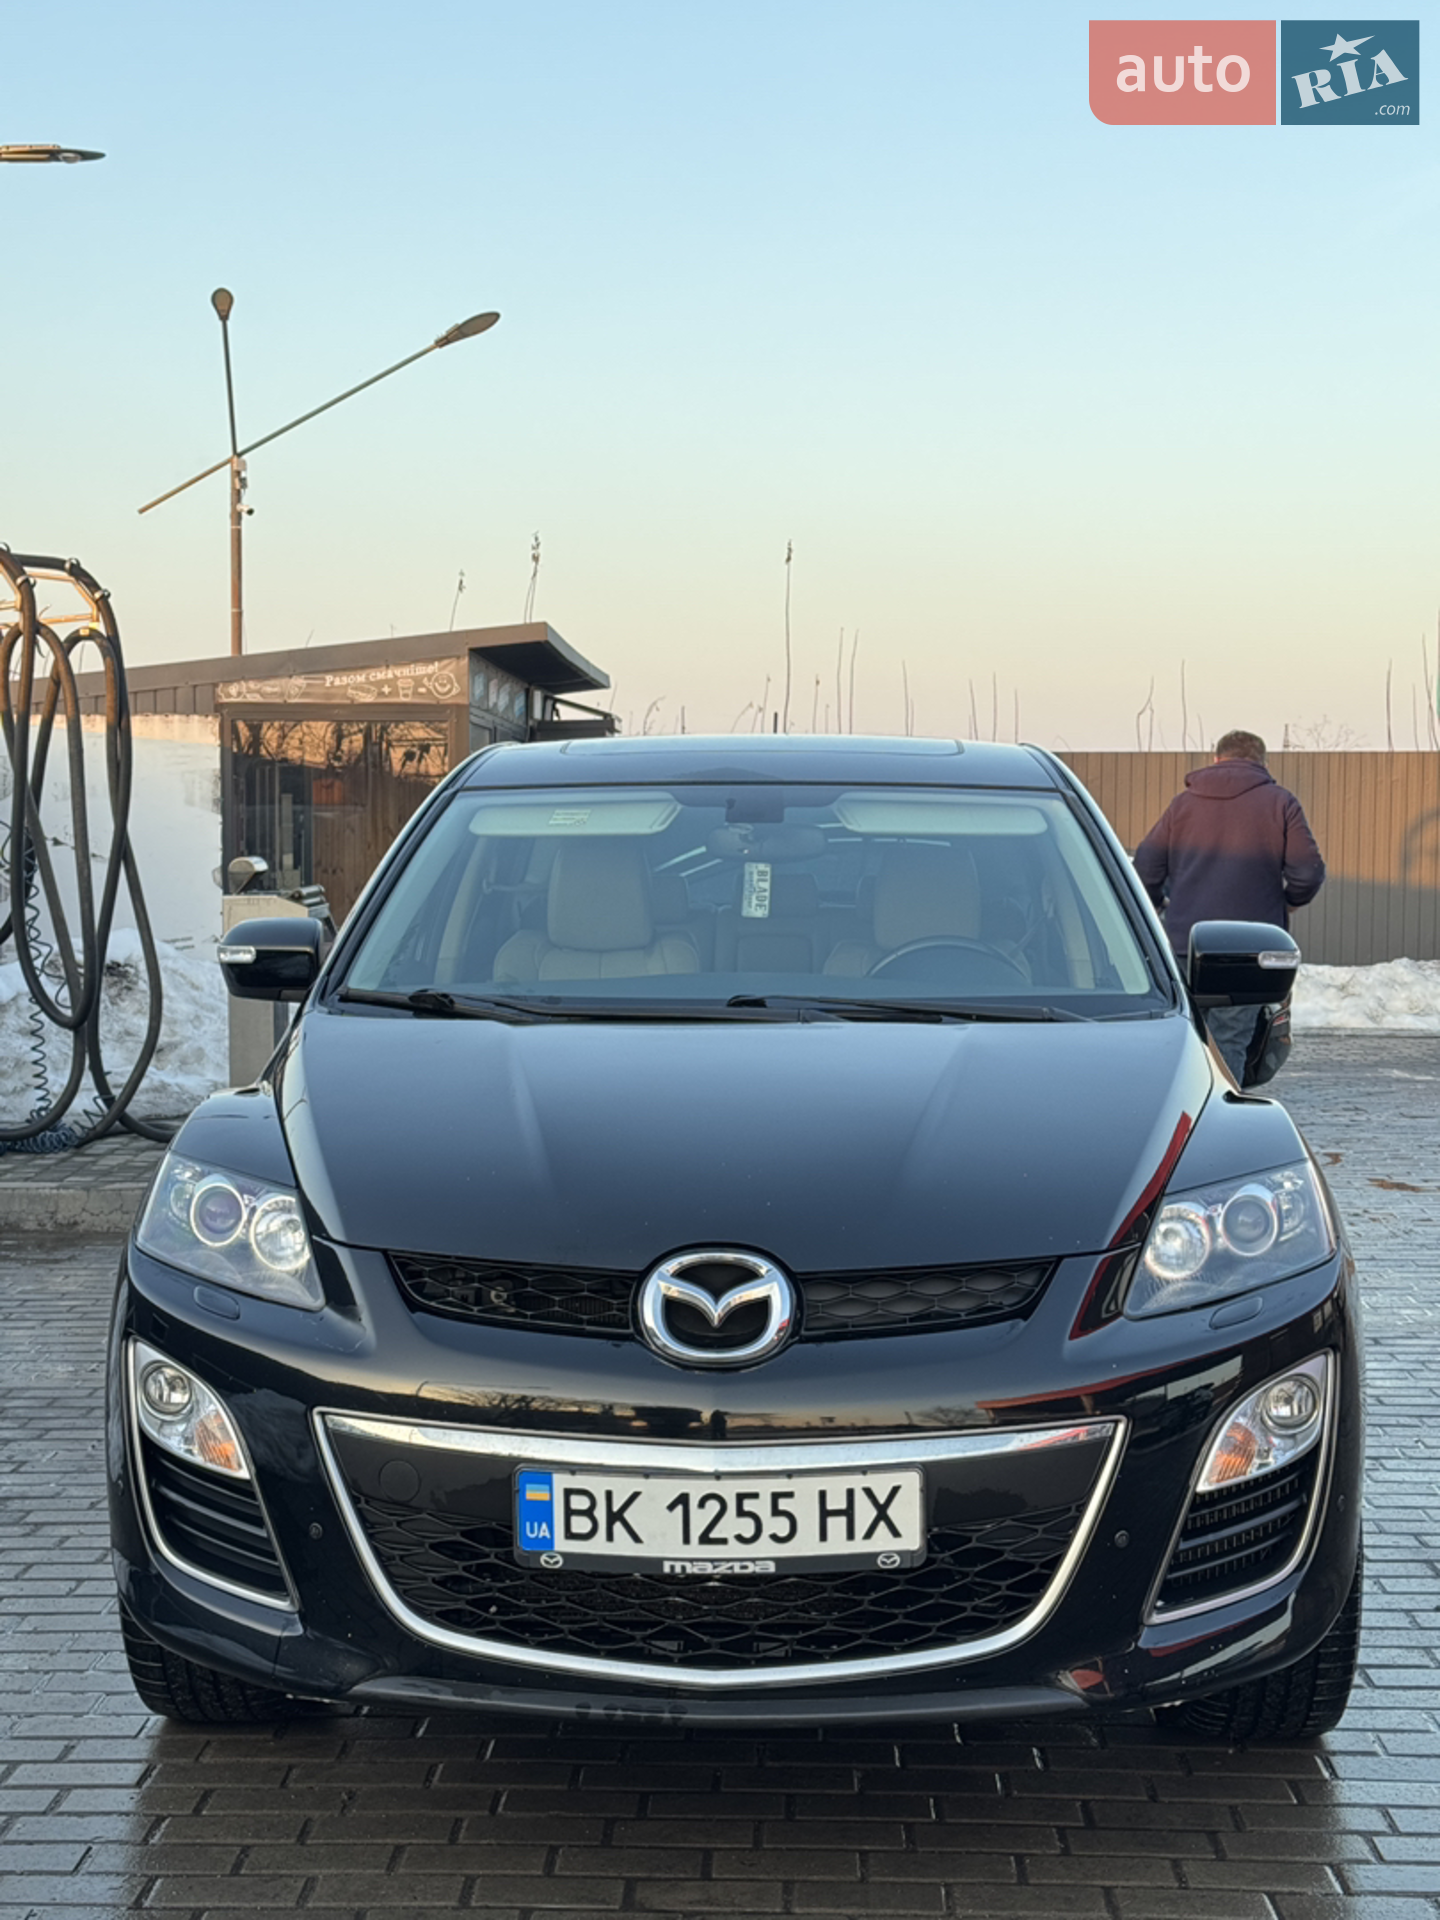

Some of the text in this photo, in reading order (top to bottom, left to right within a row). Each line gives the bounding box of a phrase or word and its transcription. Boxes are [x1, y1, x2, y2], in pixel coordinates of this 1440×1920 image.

[324, 673, 367, 687] Разом
[754, 870, 769, 912] BLADE
[526, 1521, 551, 1539] UA
[562, 1485, 902, 1545] BK 1255 HX
